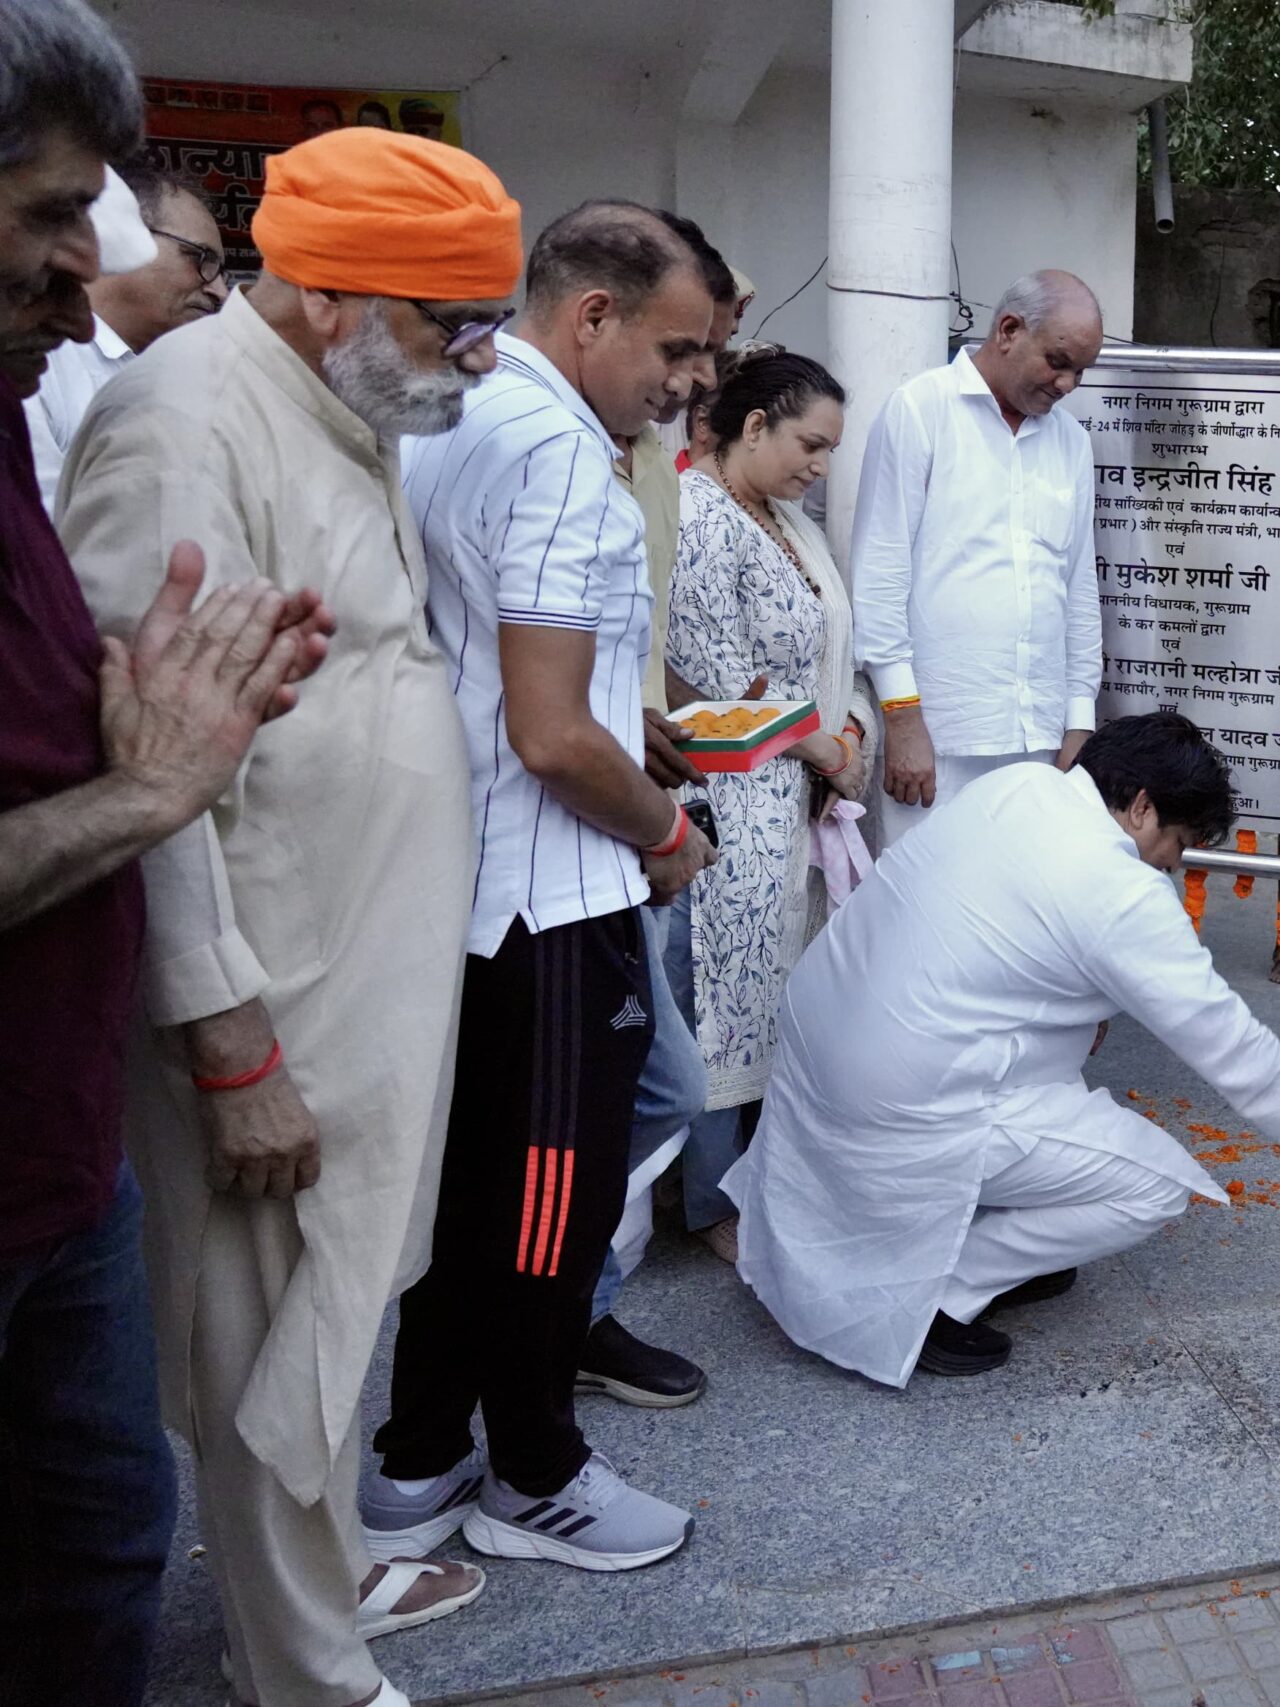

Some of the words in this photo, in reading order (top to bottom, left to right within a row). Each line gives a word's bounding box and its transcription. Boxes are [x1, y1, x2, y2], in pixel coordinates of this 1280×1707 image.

[1102, 396, 1131, 408] नगर
[1135, 393, 1172, 410] निगम
[1177, 399, 1230, 414] गुरूग्राम
[1234, 401, 1264, 415] द्वारा
[1112, 421, 1120, 432] में
[1122, 420, 1142, 433] शिव
[1145, 421, 1166, 435] मंदिर
[1169, 424, 1195, 437] जोहड़
[1198, 424, 1207, 436] के
[1257, 427, 1267, 438] के
[1152, 443, 1208, 457] शुभारम्भ
[1133, 462, 1220, 492] इन्द्रजीत
[1227, 464, 1275, 495] सिंह
[1115, 497, 1164, 513] सांख्यिकी
[1167, 500, 1184, 513] एवं
[1191, 502, 1236, 516] कार्यक्रम
[1100, 519, 1128, 531] प्रभार
[1141, 517, 1161, 532] और
[1164, 518, 1204, 536] संस्कृति
[1206, 523, 1232, 536] राज्य
[1235, 522, 1262, 539] मंत्री,
[1166, 542, 1185, 556] एवं
[1116, 558, 1177, 588] मुकेश
[1185, 564, 1234, 590] शर्मा
[1239, 565, 1270, 592] जी
[1145, 595, 1200, 613] विधायक,
[1204, 602, 1251, 617] गुरूग्राम
[1119, 617, 1132, 629] के
[1135, 620, 1154, 631] कर
[1159, 618, 1198, 633] कमलों
[1201, 623, 1226, 636] द्वारा
[1161, 638, 1180, 651] एवं
[1115, 656, 1187, 678] राजरानी
[1192, 661, 1261, 685] मल्होत्रा
[1114, 680, 1160, 697] महापौर,
[1164, 687, 1189, 698] नगर
[1193, 687, 1226, 702] निगम
[1228, 693, 1275, 706] गुरूग्राम
[1220, 729, 1268, 750] यादव
